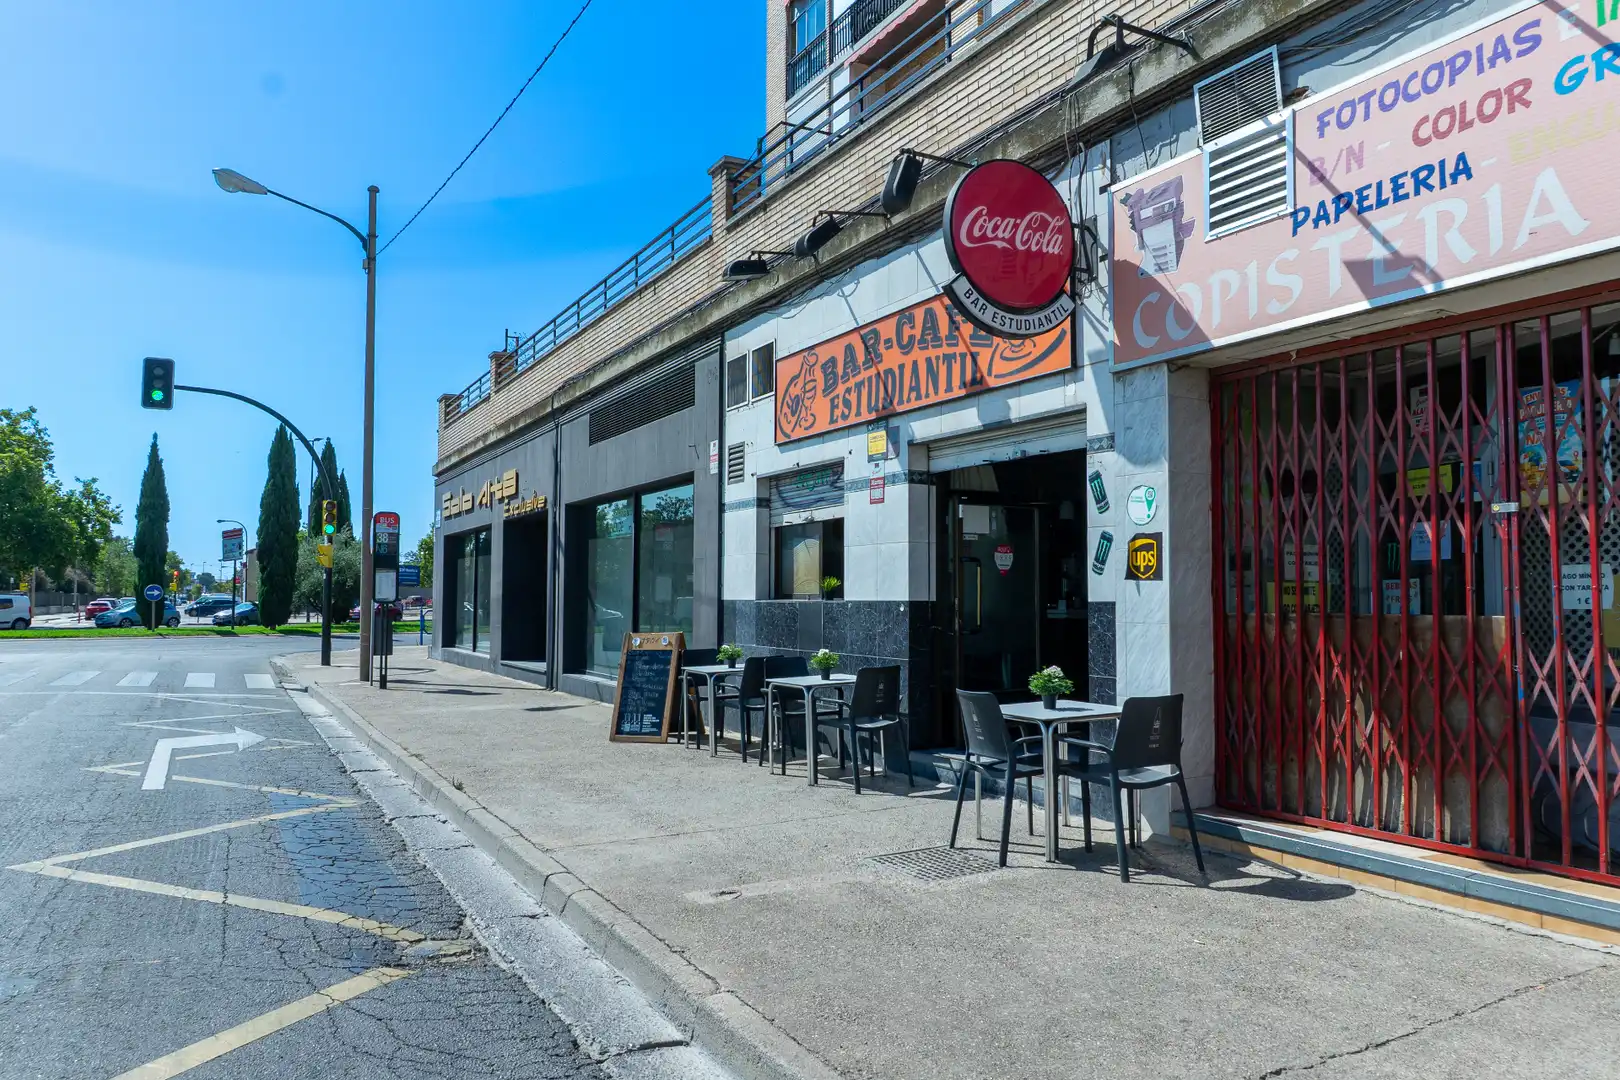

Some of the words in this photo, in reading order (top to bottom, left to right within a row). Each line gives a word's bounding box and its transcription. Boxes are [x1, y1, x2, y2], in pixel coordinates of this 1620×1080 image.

[1316, 18, 1543, 139] FOTOCOPIAS
[1308, 140, 1366, 188] B/N
[1412, 77, 1533, 148] COLOR
[1290, 151, 1474, 238] PAPELERIA
[1132, 166, 1592, 350] COPISTERIA
[963, 288, 988, 316] BAR
[991, 303, 1070, 331] ESTUDIANTIL
[828, 351, 984, 426] ESTUDIANTIL
[376, 532, 389, 543] 38
[379, 516, 395, 524] BUS
[1132, 551, 1155, 572] ups
